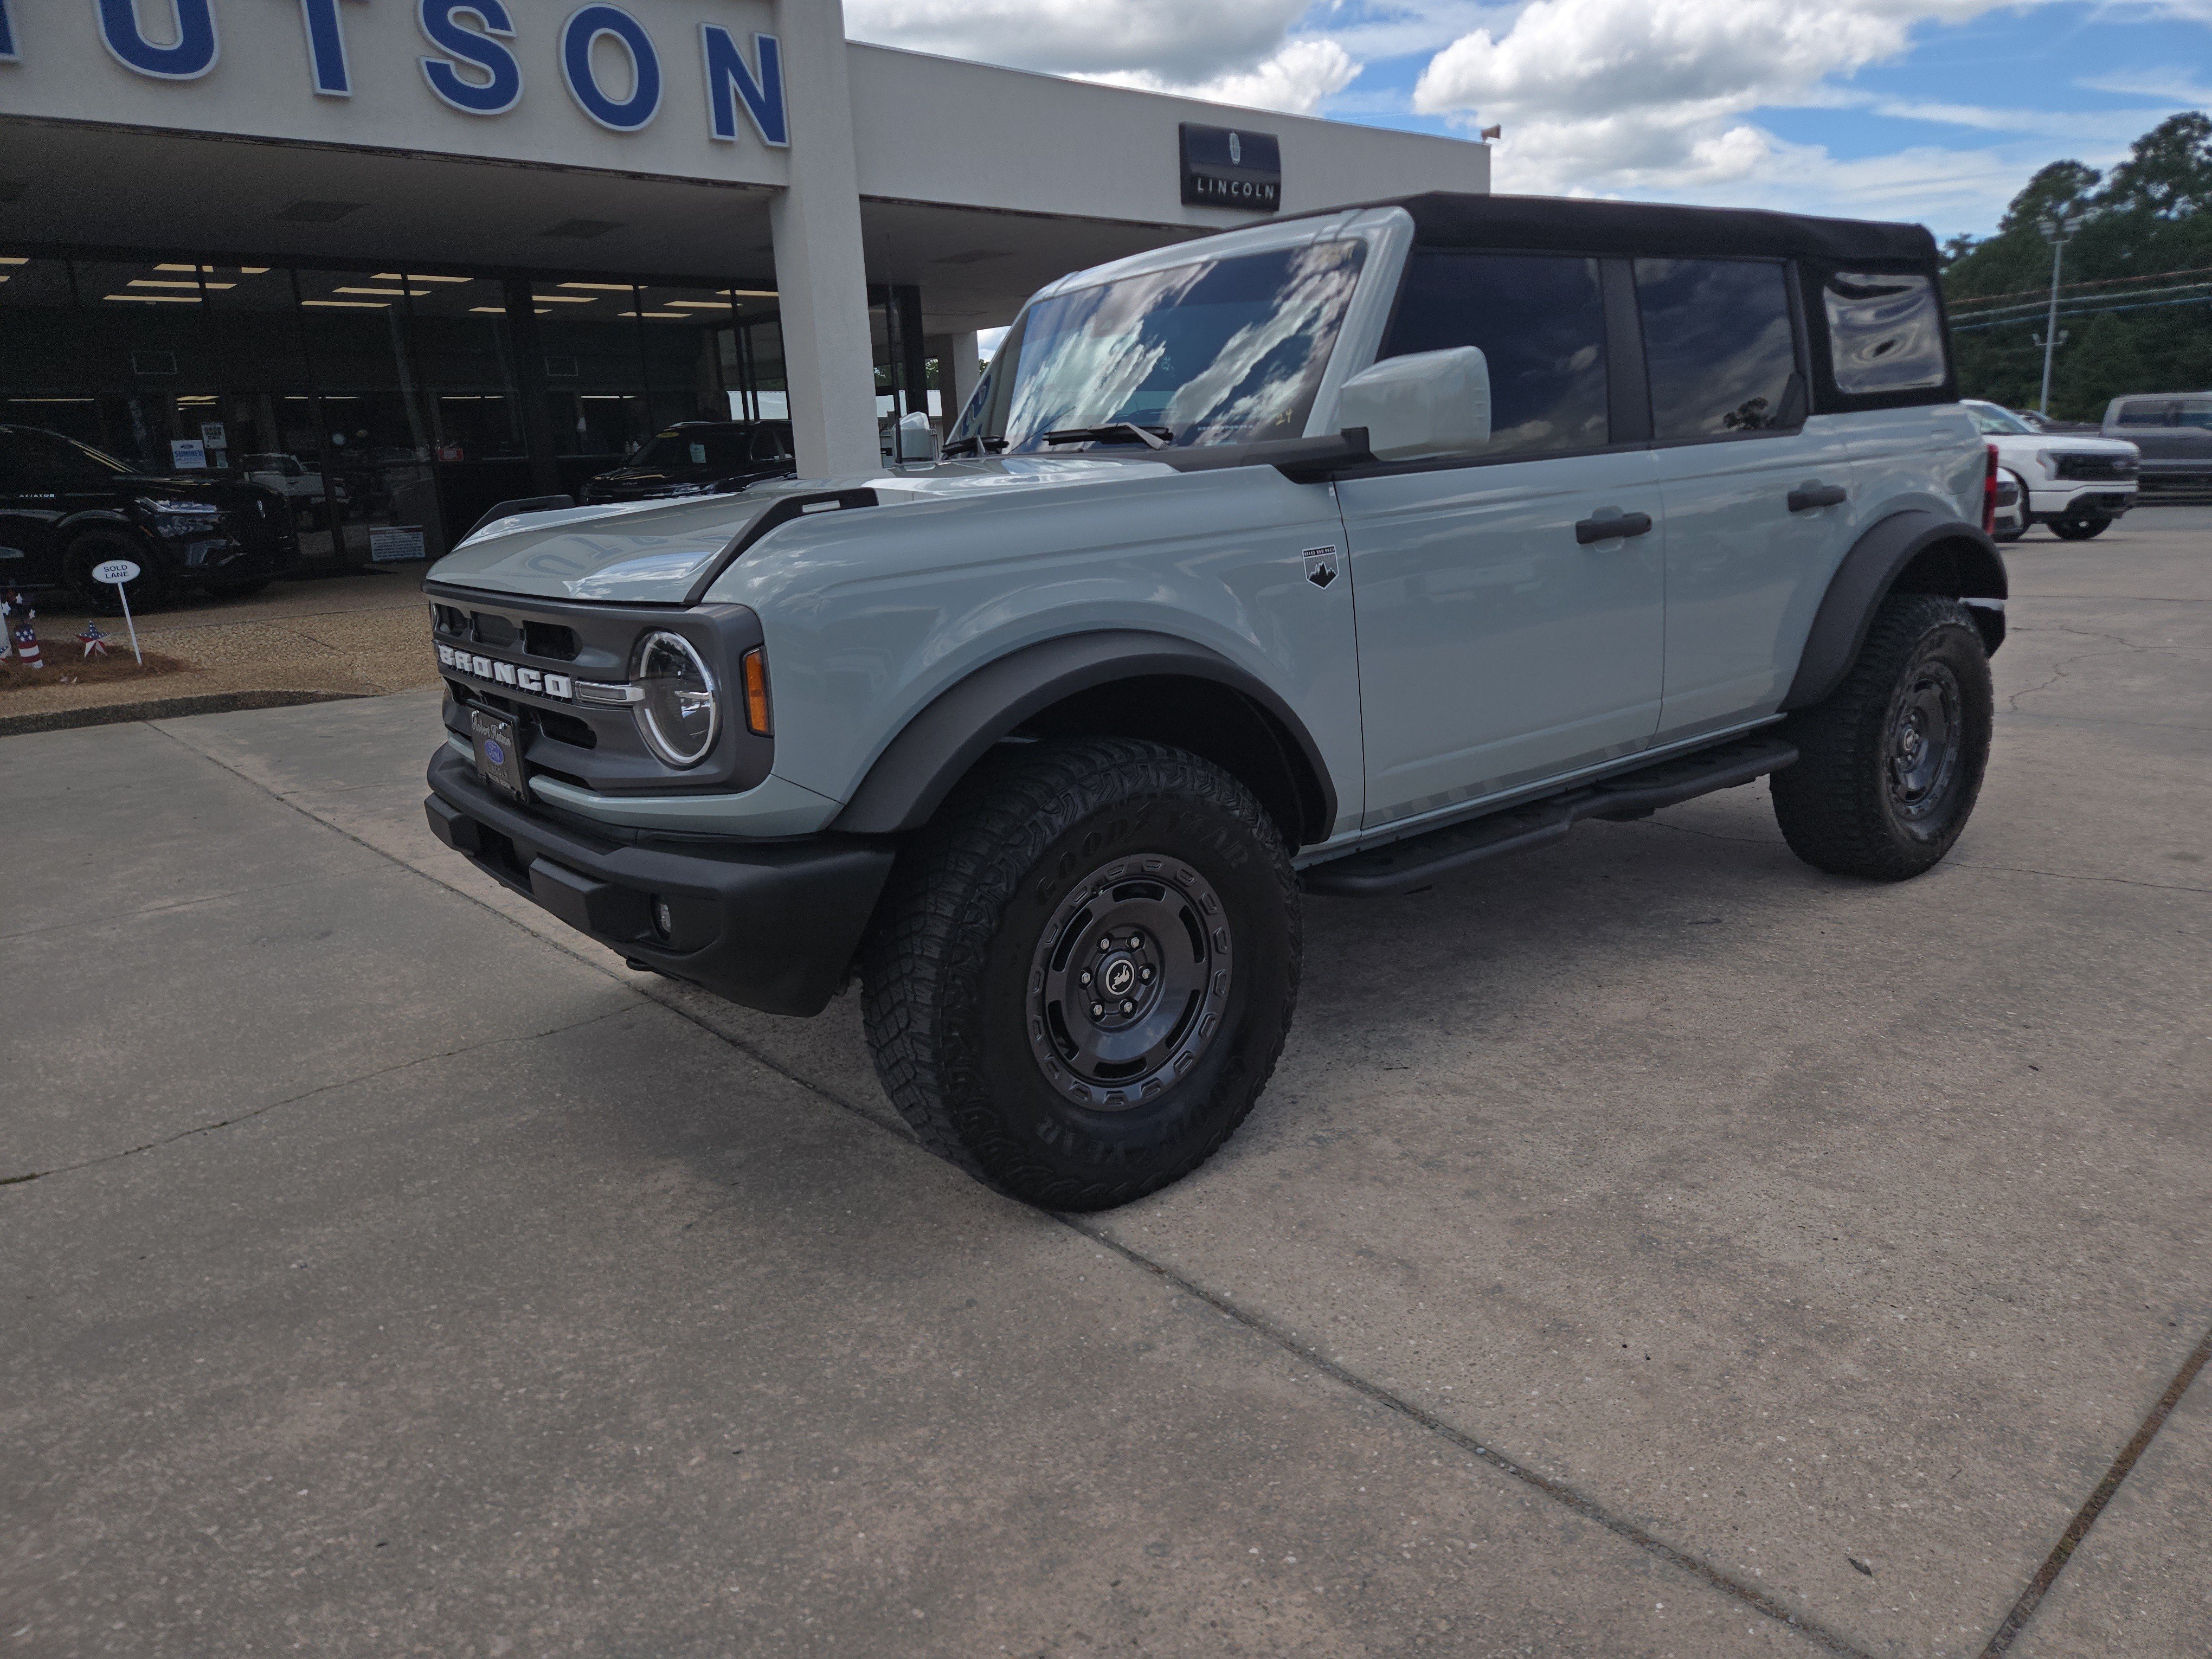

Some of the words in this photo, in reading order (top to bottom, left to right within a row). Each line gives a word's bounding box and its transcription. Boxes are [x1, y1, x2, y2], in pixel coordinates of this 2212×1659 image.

[0, 0, 789, 147] UTSON
[1197, 177, 1275, 200] LINCOLN
[105, 571, 130, 579] LANE
[438, 645, 573, 698] BRONCO
